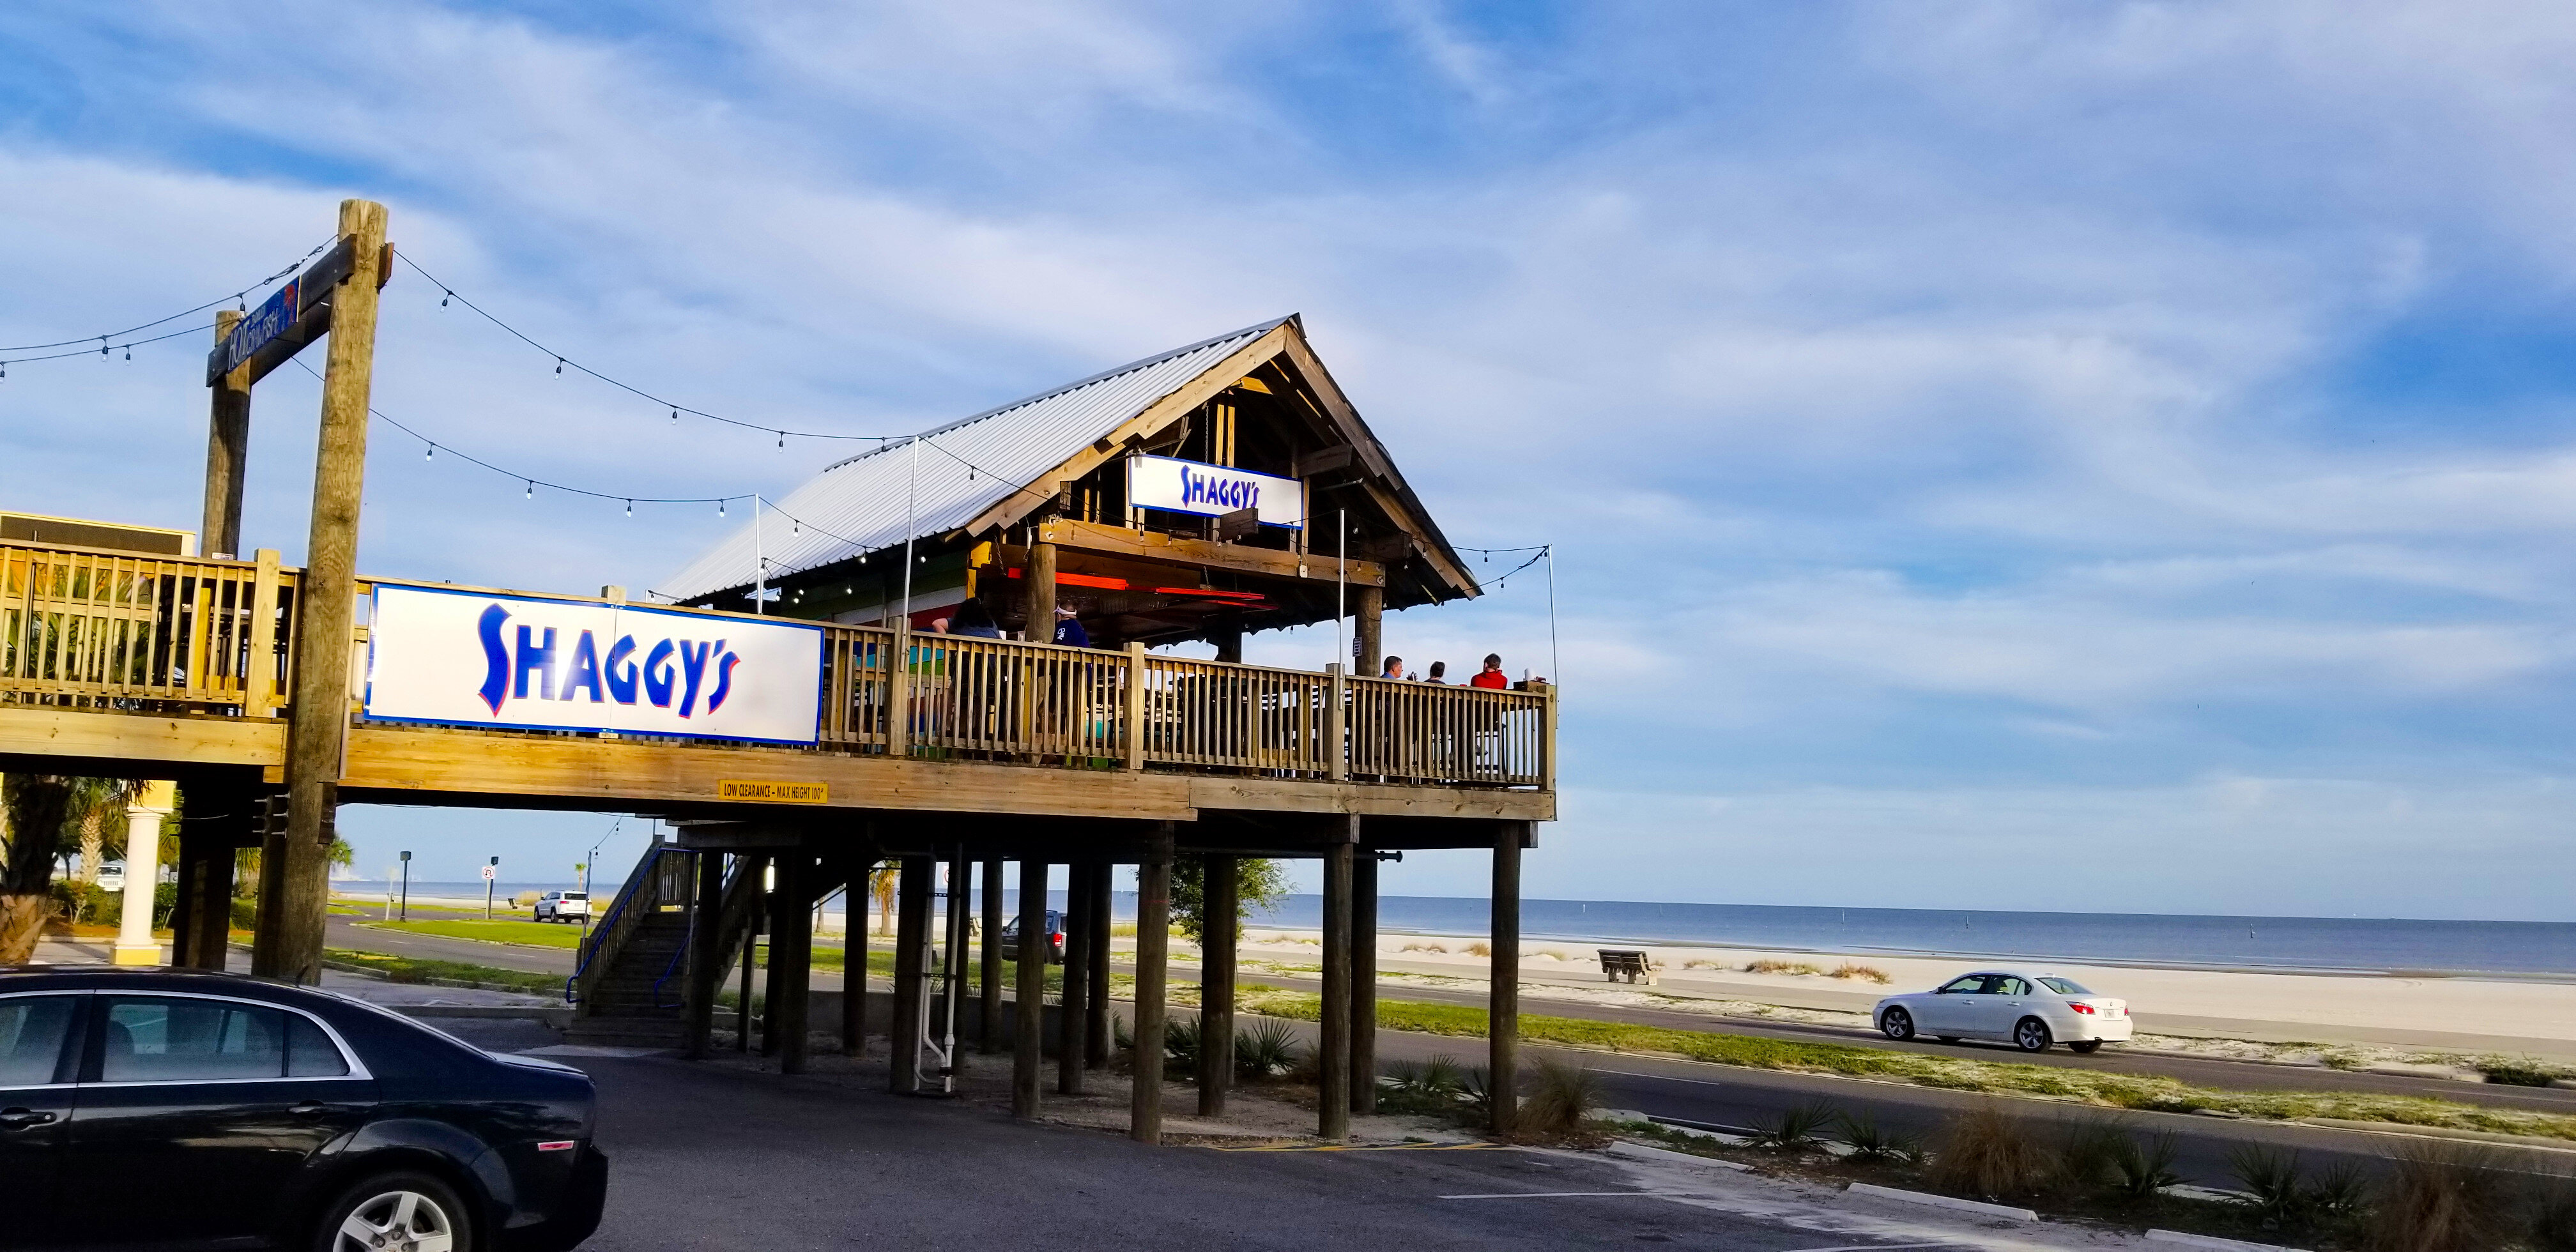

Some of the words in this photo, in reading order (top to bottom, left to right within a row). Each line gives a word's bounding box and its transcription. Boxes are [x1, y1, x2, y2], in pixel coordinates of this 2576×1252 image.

[228, 319, 250, 370] HOT
[1181, 464, 1260, 509] SHAGGY'S
[477, 602, 741, 719] SHAGGY'S
[724, 783, 738, 797] LOW
[739, 783, 770, 798] CLEARANCE
[777, 786, 790, 798] MAX
[792, 786, 811, 800] HEIGHT
